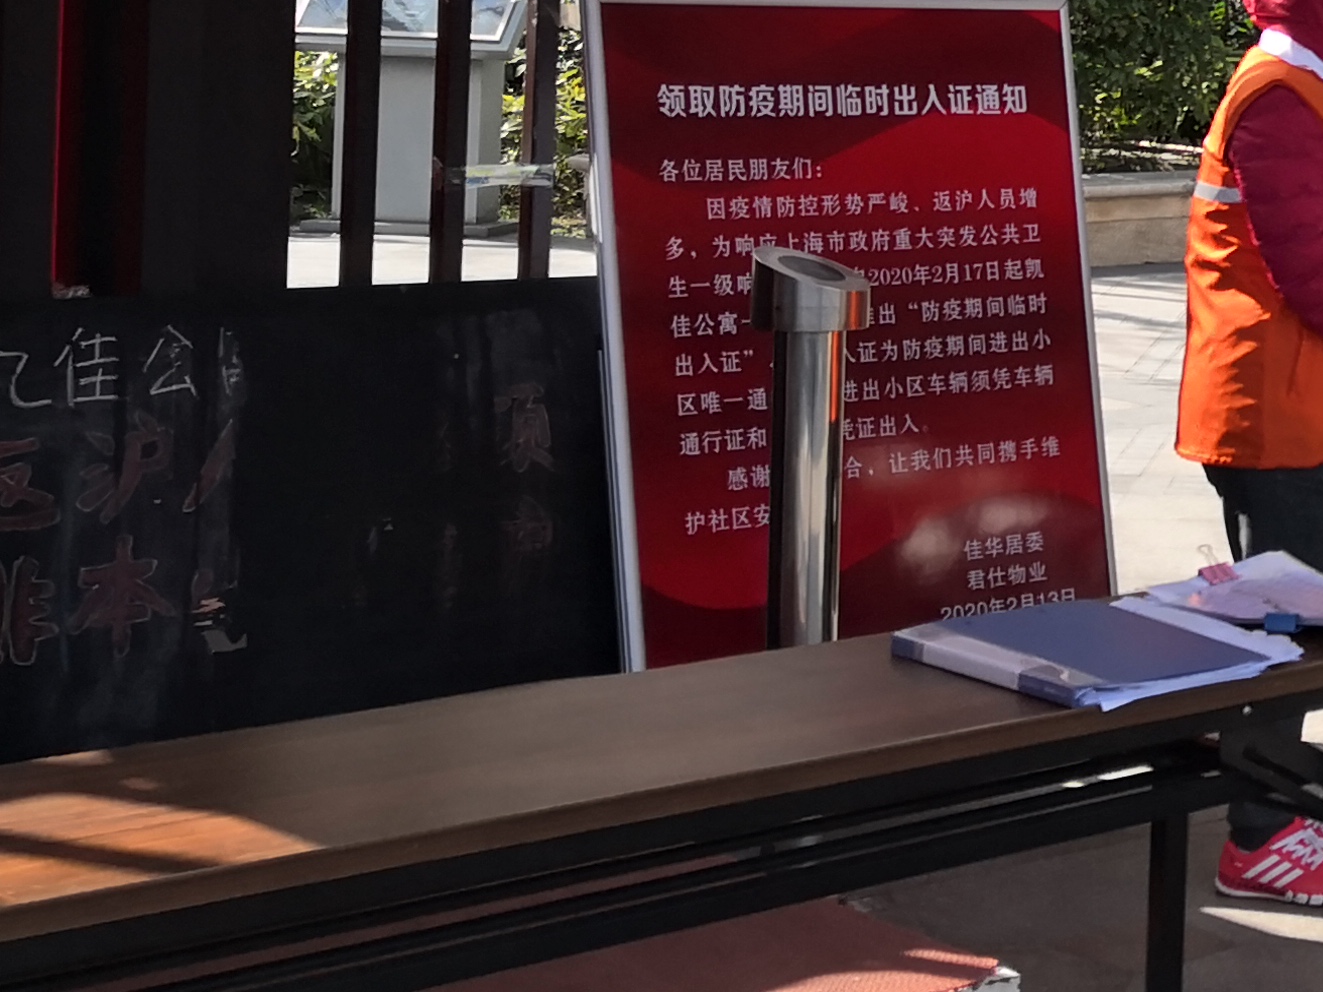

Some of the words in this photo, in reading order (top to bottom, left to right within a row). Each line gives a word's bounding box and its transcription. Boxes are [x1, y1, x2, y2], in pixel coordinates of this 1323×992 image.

[657, 82, 1029, 119] 领取防疫期间临时出入证通知
[659, 156, 824, 184] 各位居民朋友们：
[706, 185, 1039, 220] 因疫情防控形势严峻、返沪人员增
[963, 530, 1045, 564] 佳华居委
[966, 560, 1049, 591] 君仕物业
[940, 586, 1077, 622] 2020年2月13日
